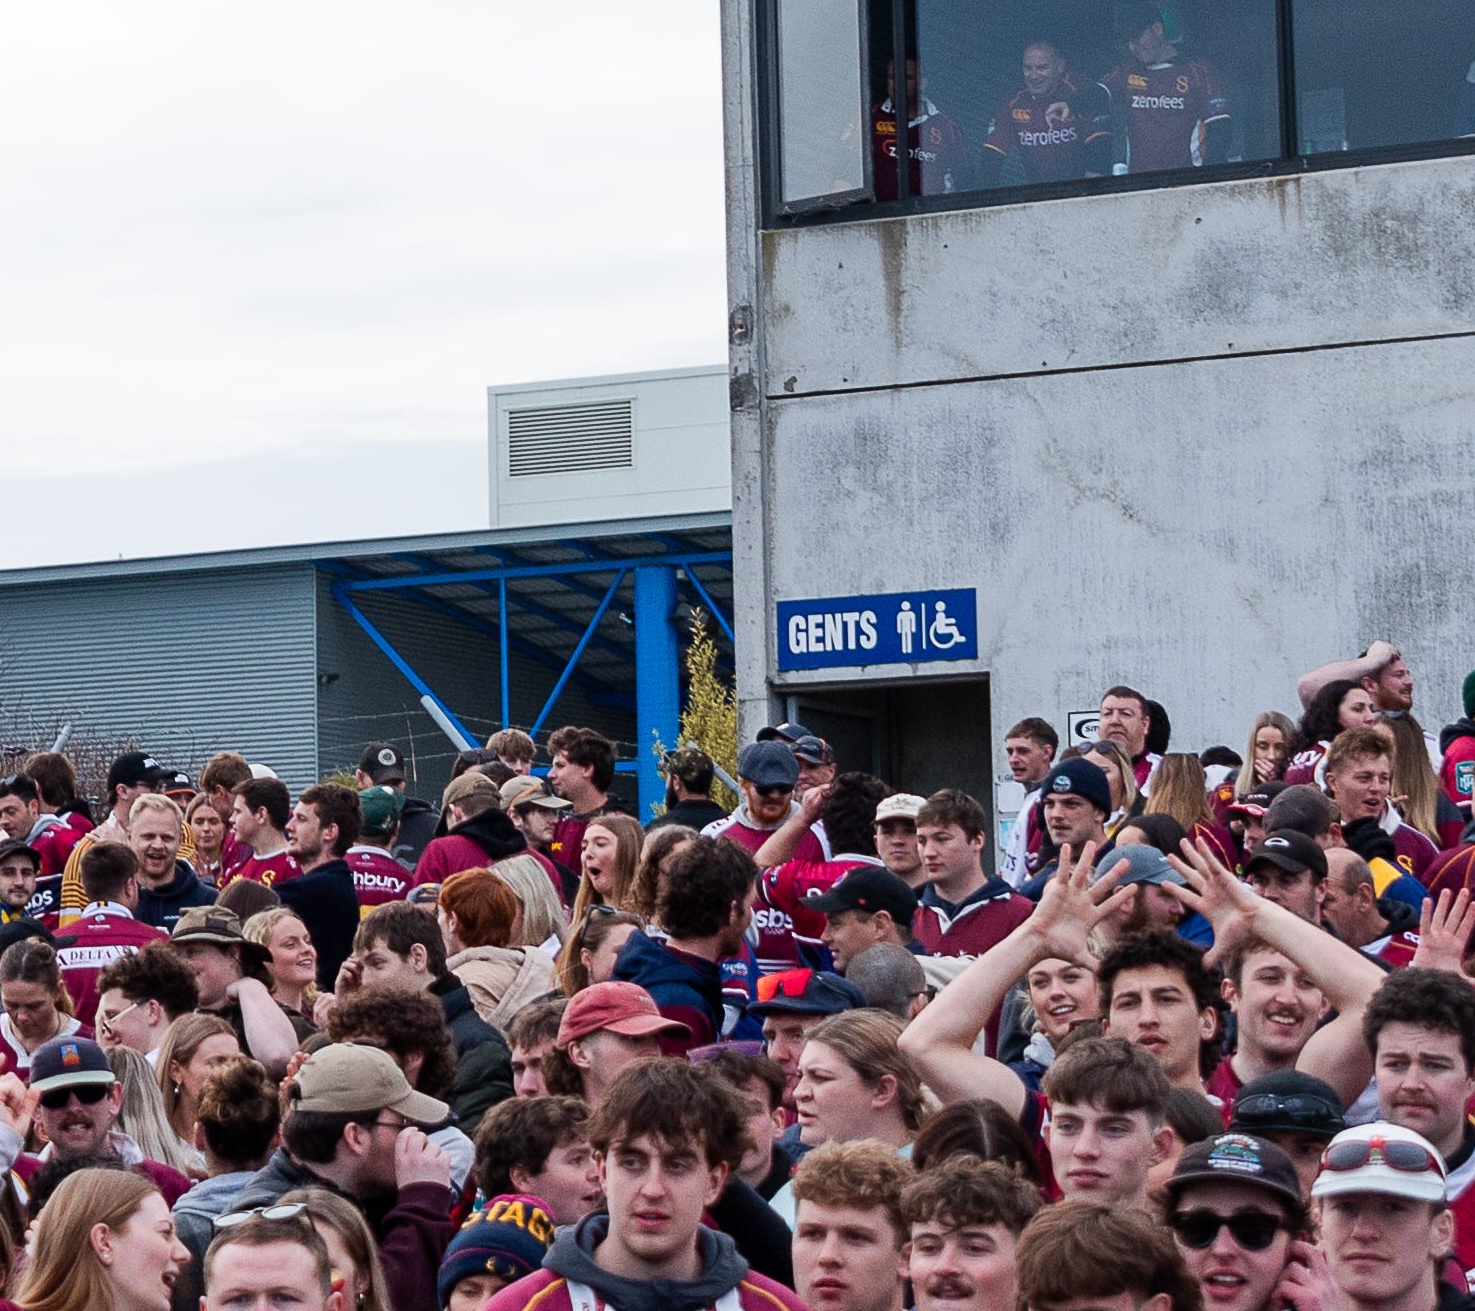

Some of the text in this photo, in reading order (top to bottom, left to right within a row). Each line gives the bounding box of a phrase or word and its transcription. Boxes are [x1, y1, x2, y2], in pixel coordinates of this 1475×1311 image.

[1131, 95, 1185, 110] zerofees
[1018, 126, 1078, 147] zerofees
[788, 609, 878, 657] GENTS
[352, 871, 406, 893] hbury
[755, 907, 793, 930] sbs
[70, 950, 112, 961] DELTA
[461, 1200, 556, 1243] STAG
